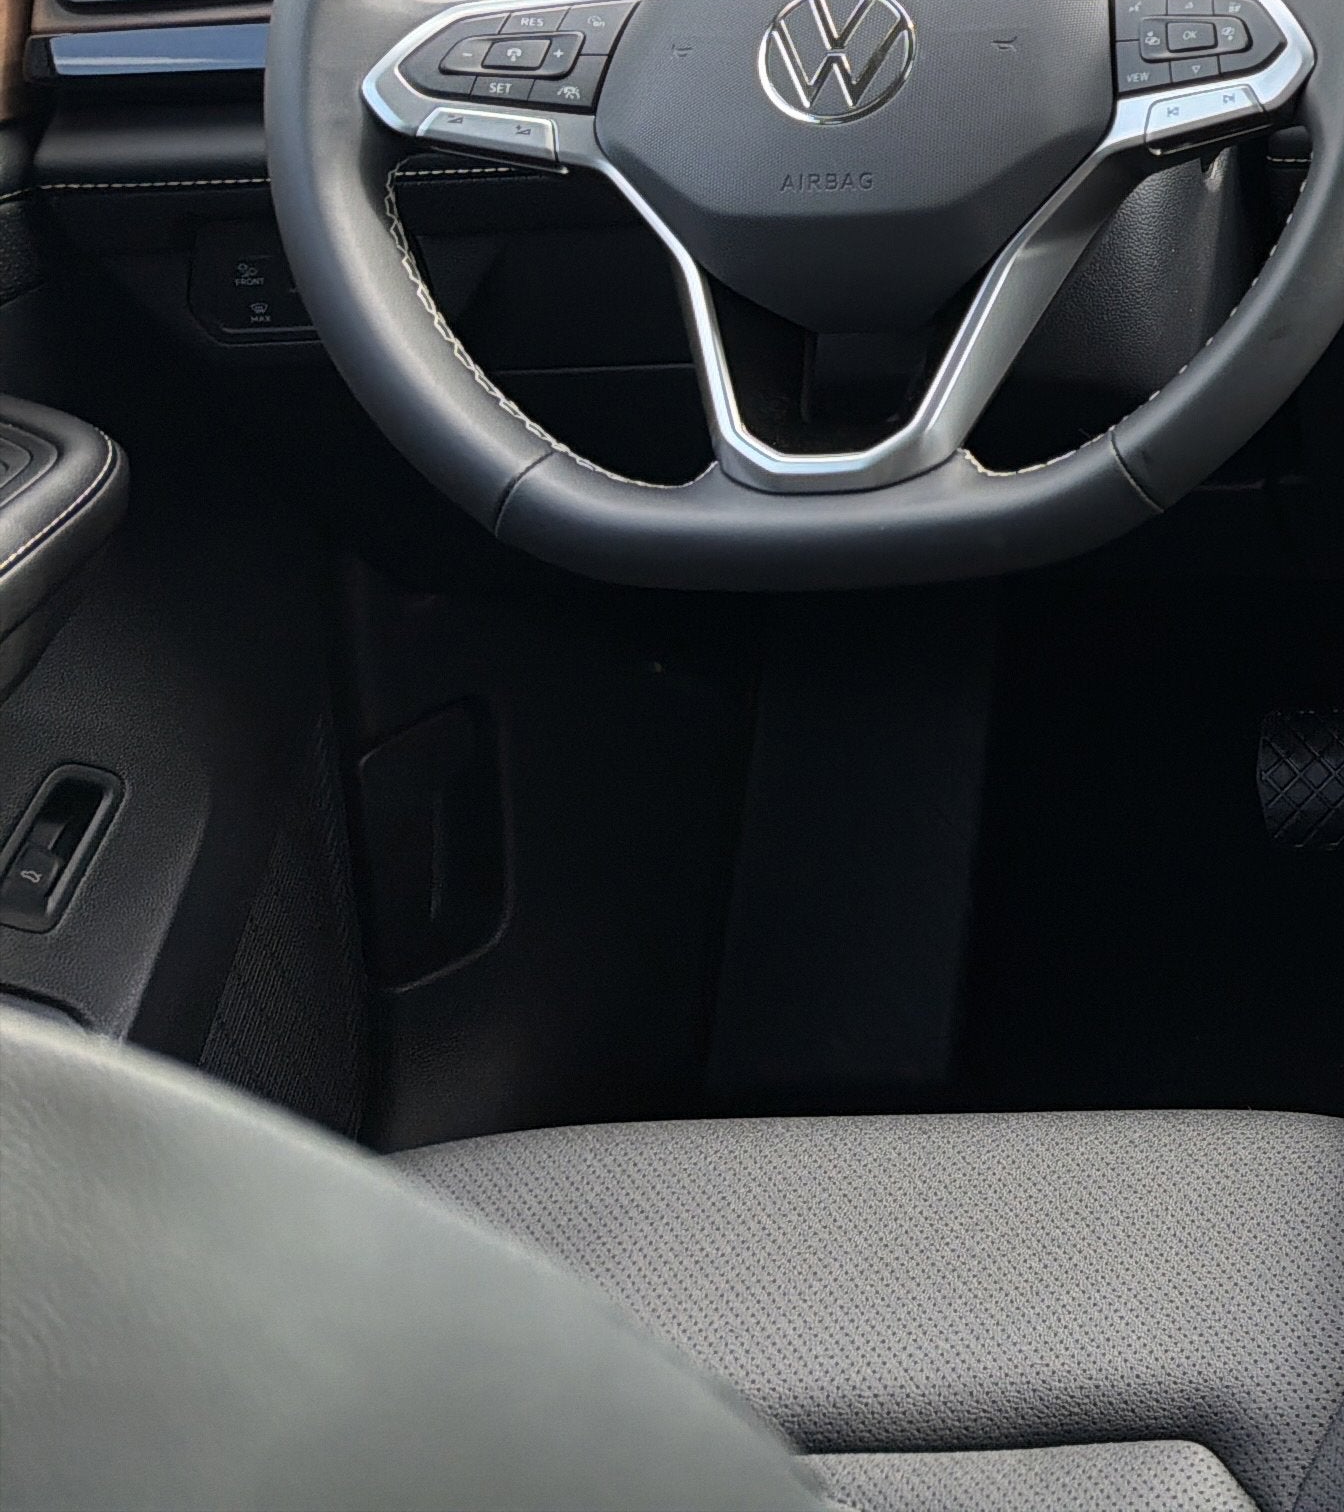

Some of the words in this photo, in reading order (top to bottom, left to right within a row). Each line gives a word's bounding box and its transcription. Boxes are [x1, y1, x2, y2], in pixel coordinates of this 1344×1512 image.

[520, 16, 544, 27] RES
[1182, 29, 1198, 41] OK
[1126, 71, 1150, 83] VIEW
[488, 82, 512, 94] SET
[780, 172, 874, 192] AIRBAG
[234, 277, 265, 287] FRONT
[250, 315, 271, 323] MAX
